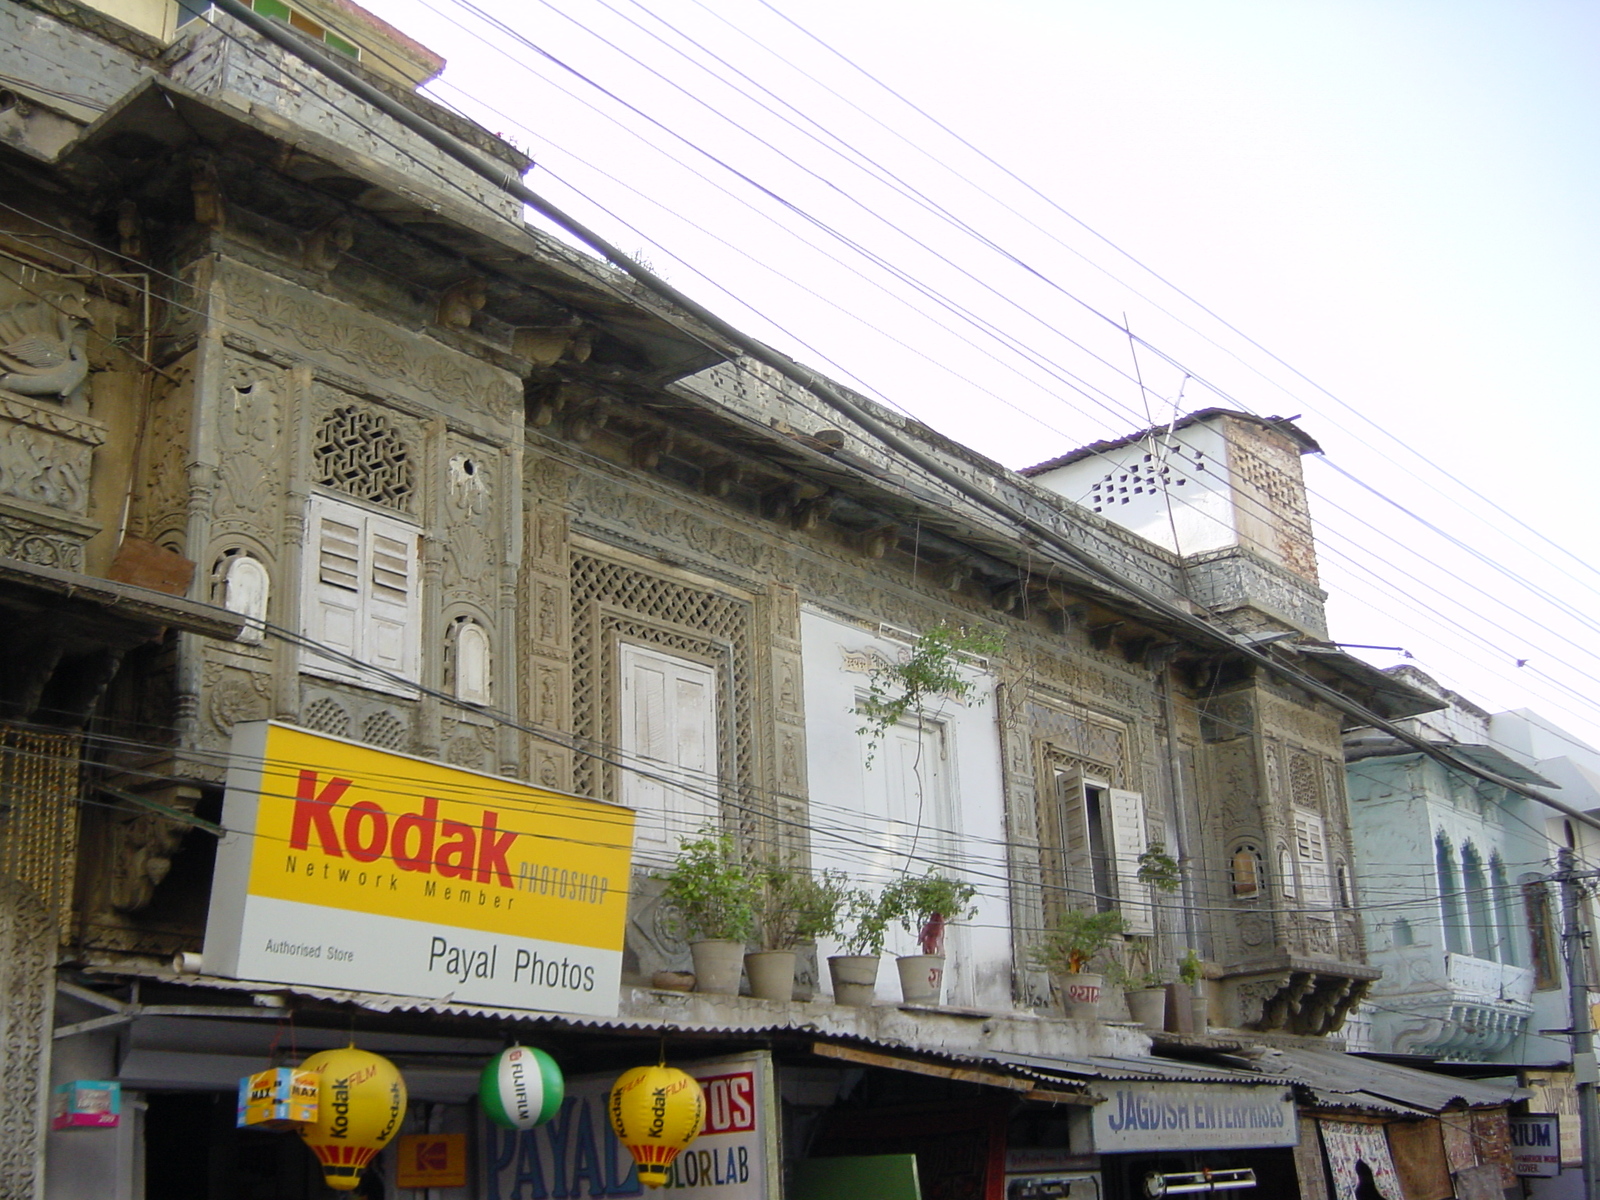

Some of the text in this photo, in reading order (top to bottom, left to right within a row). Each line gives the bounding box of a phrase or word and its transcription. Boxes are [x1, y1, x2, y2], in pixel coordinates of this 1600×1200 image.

[289, 769, 519, 889] Kodak
[286, 855, 515, 910] Network Member
[518, 861, 608, 905] PHOTOSHOP
[265, 938, 355, 963] Authorised Store
[429, 936, 595, 992] Payal Photos
[251, 1087, 271, 1100] MAX
[292, 1086, 318, 1098] MAX
[349, 1064, 377, 1088] FILM
[511, 1063, 529, 1120] FUJIFILM
[666, 1079, 689, 1097] FILM
[329, 1078, 349, 1139] Kodak
[612, 1087, 627, 1138] Kodak
[648, 1088, 666, 1138] Kodak
[1108, 1090, 1284, 1131] JAGDISH ENTERPRISES
